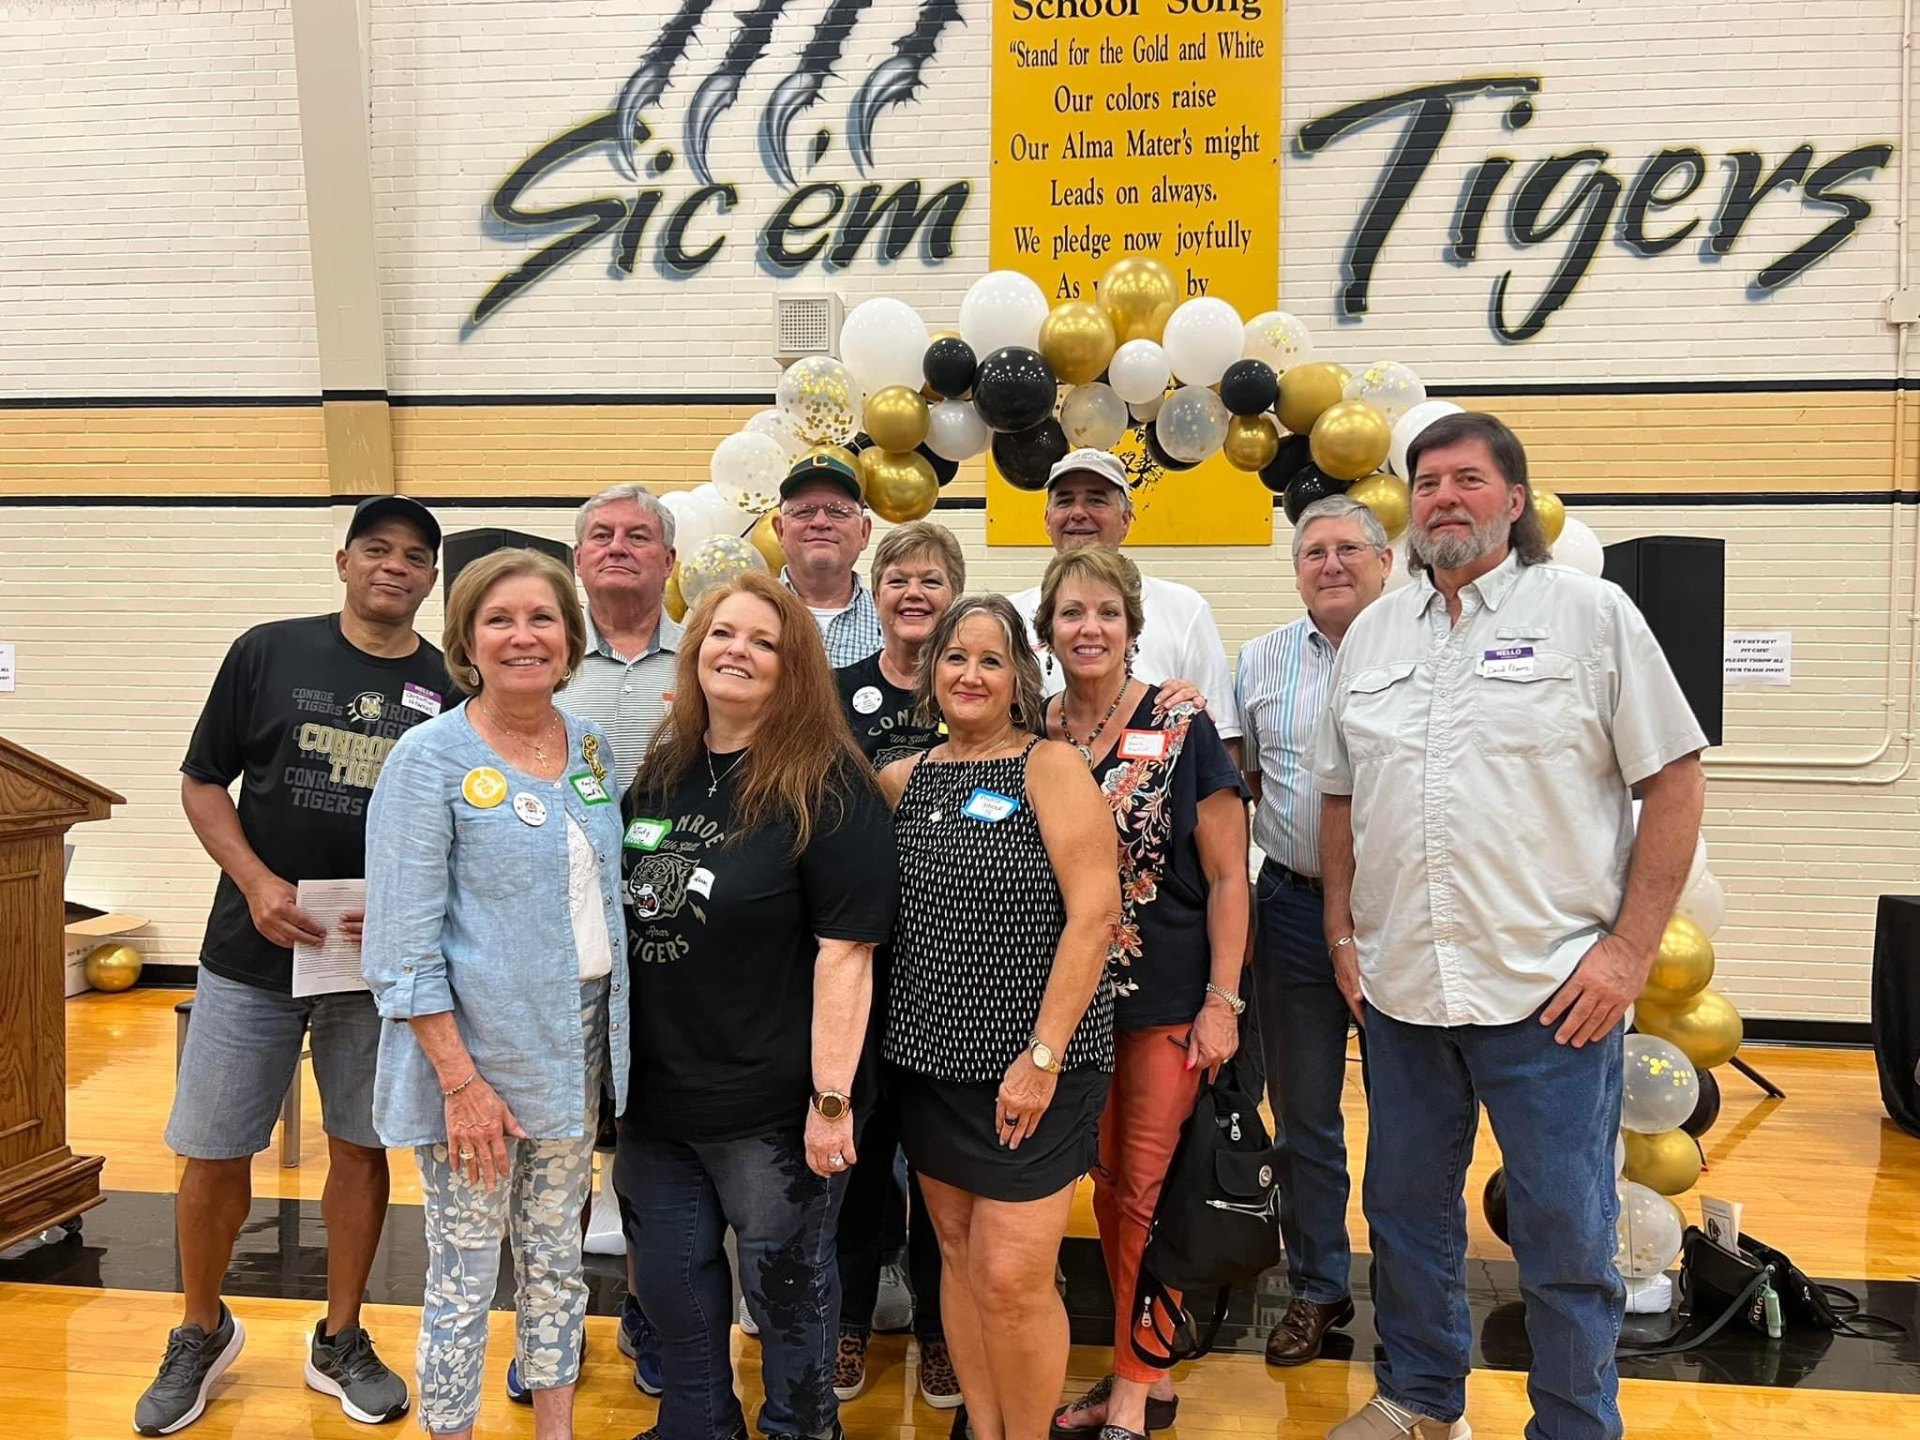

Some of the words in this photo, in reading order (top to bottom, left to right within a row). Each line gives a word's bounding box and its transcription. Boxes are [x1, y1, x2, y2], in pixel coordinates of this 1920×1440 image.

[1069, 38, 1089, 65] for
[1100, 37, 1123, 64] the
[1133, 34, 1168, 63] Gold
[1179, 32, 1207, 61] and
[1217, 31, 1264, 59] White
[1054, 85, 1093, 113] Our
[1105, 82, 1160, 111] colors
[1172, 81, 1216, 108] raise
[1010, 134, 1049, 161] Our
[1062, 131, 1113, 159] Alma
[1205, 124, 1260, 160] might
[1050, 177, 1104, 206] Leads
[1116, 186, 1139, 204] on
[1151, 175, 1217, 208] always.
[473, 112, 739, 325] Sic
[1298, 76, 1895, 341] Tigers
[1014, 226, 1040, 253] We
[1053, 224, 1111, 260] pledge
[1124, 231, 1162, 251] now
[1175, 219, 1252, 256] joyfully
[1056, 272, 1080, 299] As
[1187, 268, 1209, 298] by
[292, 688, 334, 703] CONROE
[297, 700, 343, 716] TIGERS
[291, 787, 363, 816] TIGERS
[675, 814, 724, 848] NROE
[628, 928, 690, 963] TIGERS
